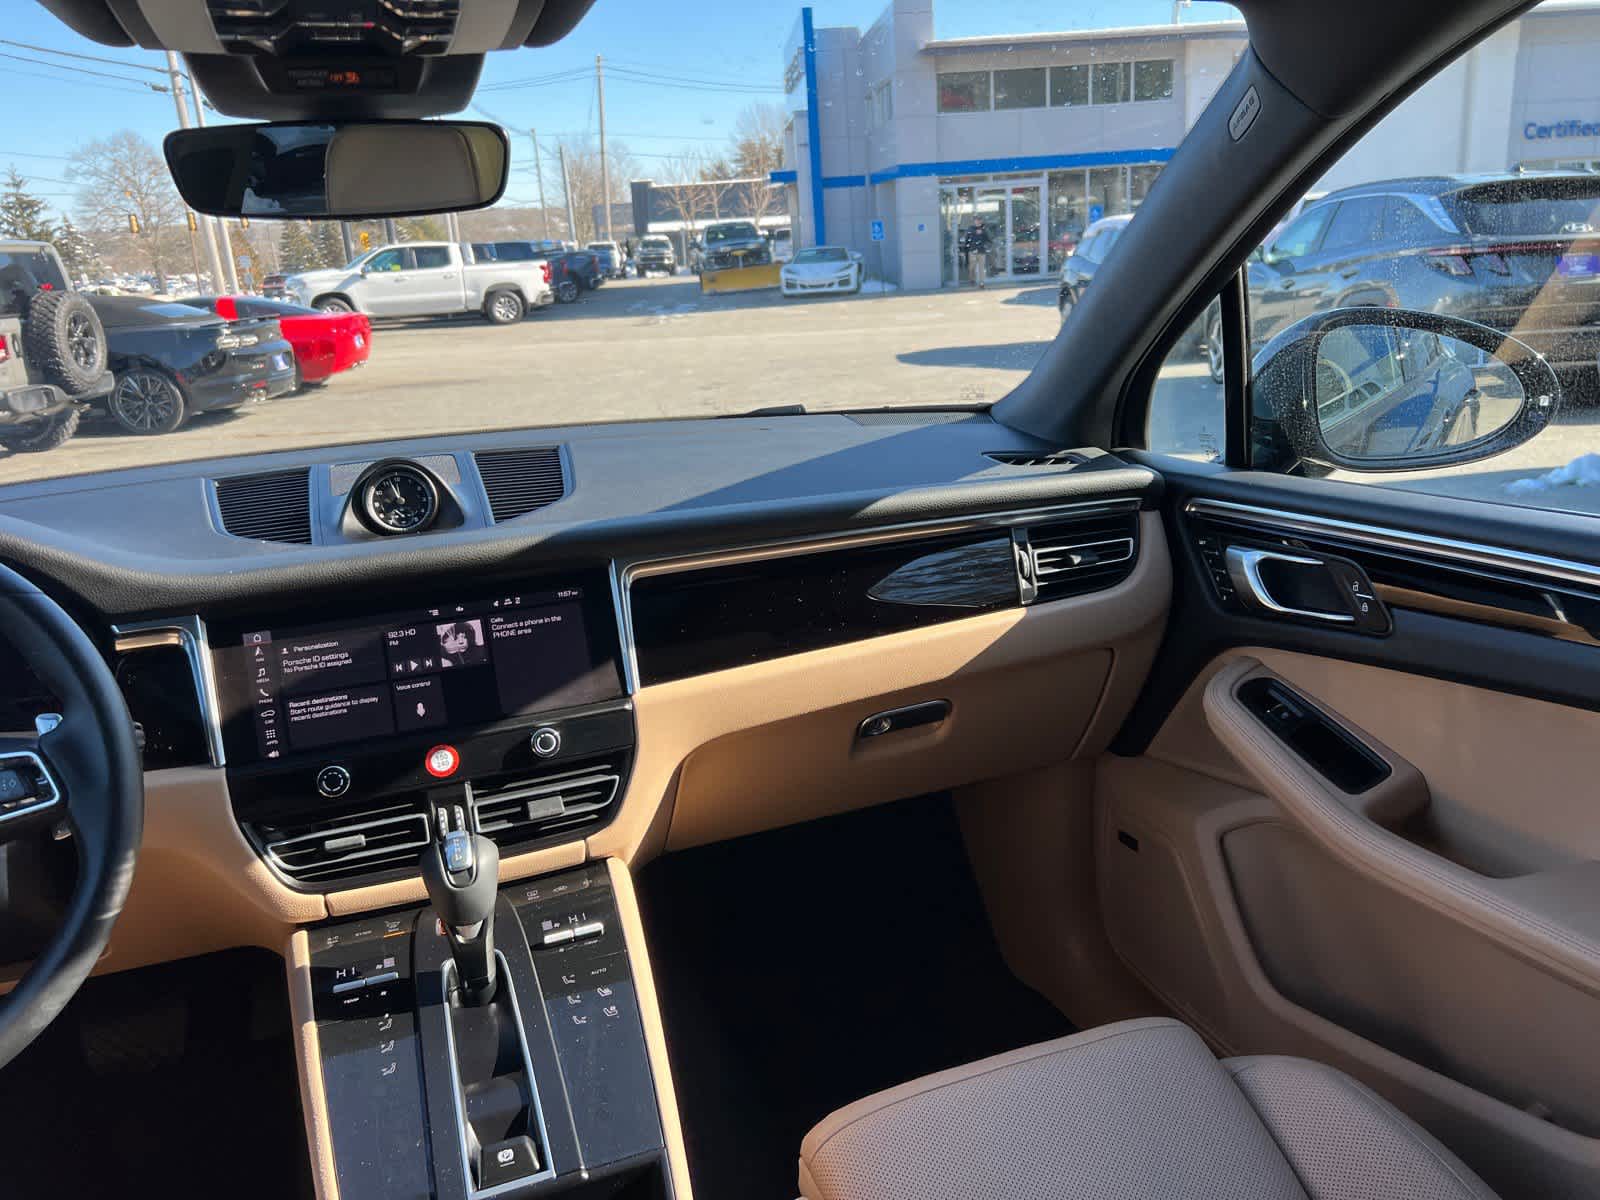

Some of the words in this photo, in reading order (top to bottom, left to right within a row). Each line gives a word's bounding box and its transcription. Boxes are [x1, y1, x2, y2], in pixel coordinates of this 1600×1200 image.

[491, 622, 518, 631] Connect
[524, 618, 544, 627] phone
[405, 628, 416, 637] HD
[493, 629, 517, 639] PHONE
[282, 657, 312, 667] Porsche
[321, 652, 349, 662] settings
[293, 663, 318, 672] Porsche
[326, 658, 353, 668] assigned
[289, 700, 311, 708] Recent
[311, 694, 348, 704] destinations
[290, 707, 307, 715] Start
[307, 705, 324, 713] route
[324, 701, 351, 711] guidance
[359, 696, 379, 704] display
[291, 714, 311, 722] recent
[312, 708, 348, 718] destinations
